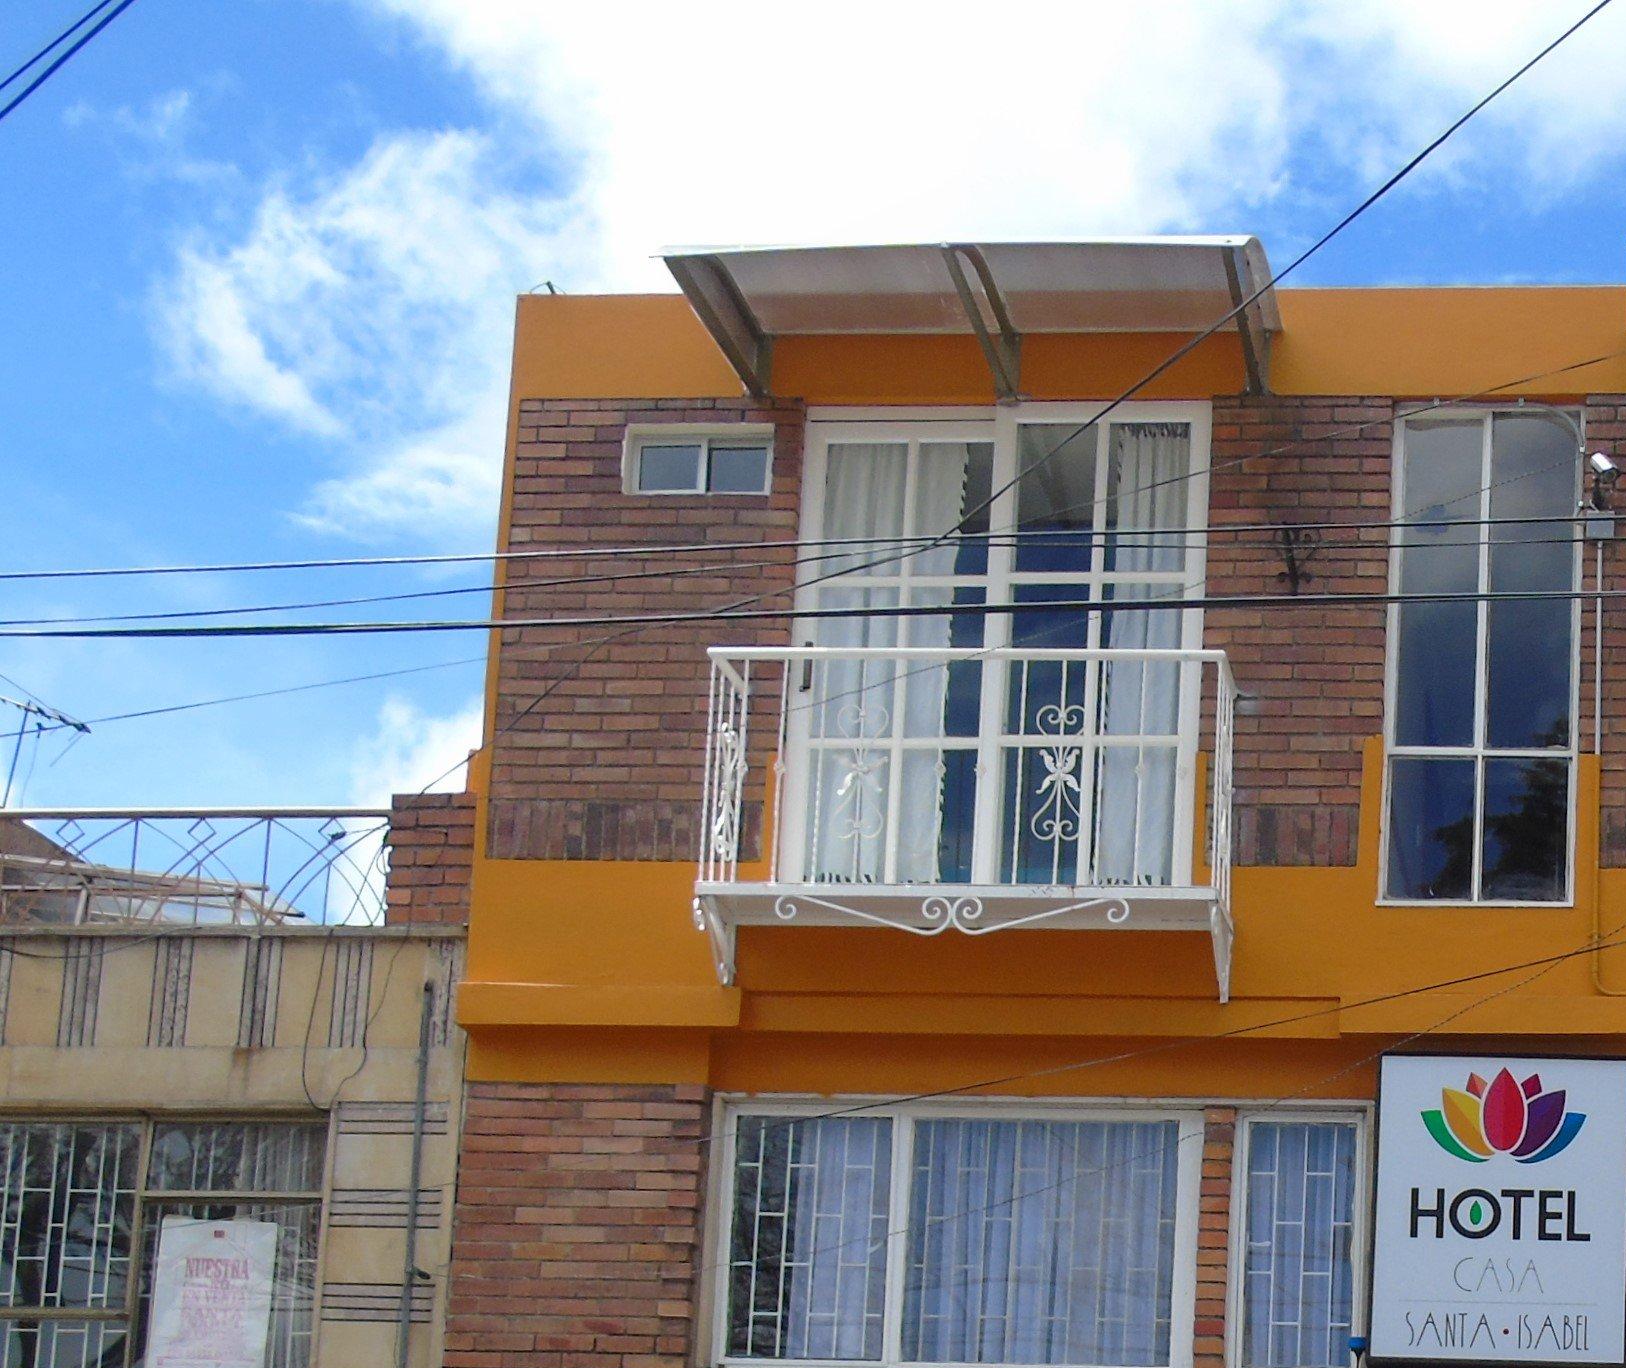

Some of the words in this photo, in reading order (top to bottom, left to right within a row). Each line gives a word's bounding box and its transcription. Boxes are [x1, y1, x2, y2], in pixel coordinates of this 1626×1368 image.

[1409, 1187, 1591, 1242] HOTEL
[1453, 1256, 1544, 1294] CASA
[1405, 1311, 1496, 1350] SANTA
[1517, 1314, 1590, 1351] ISABEL
